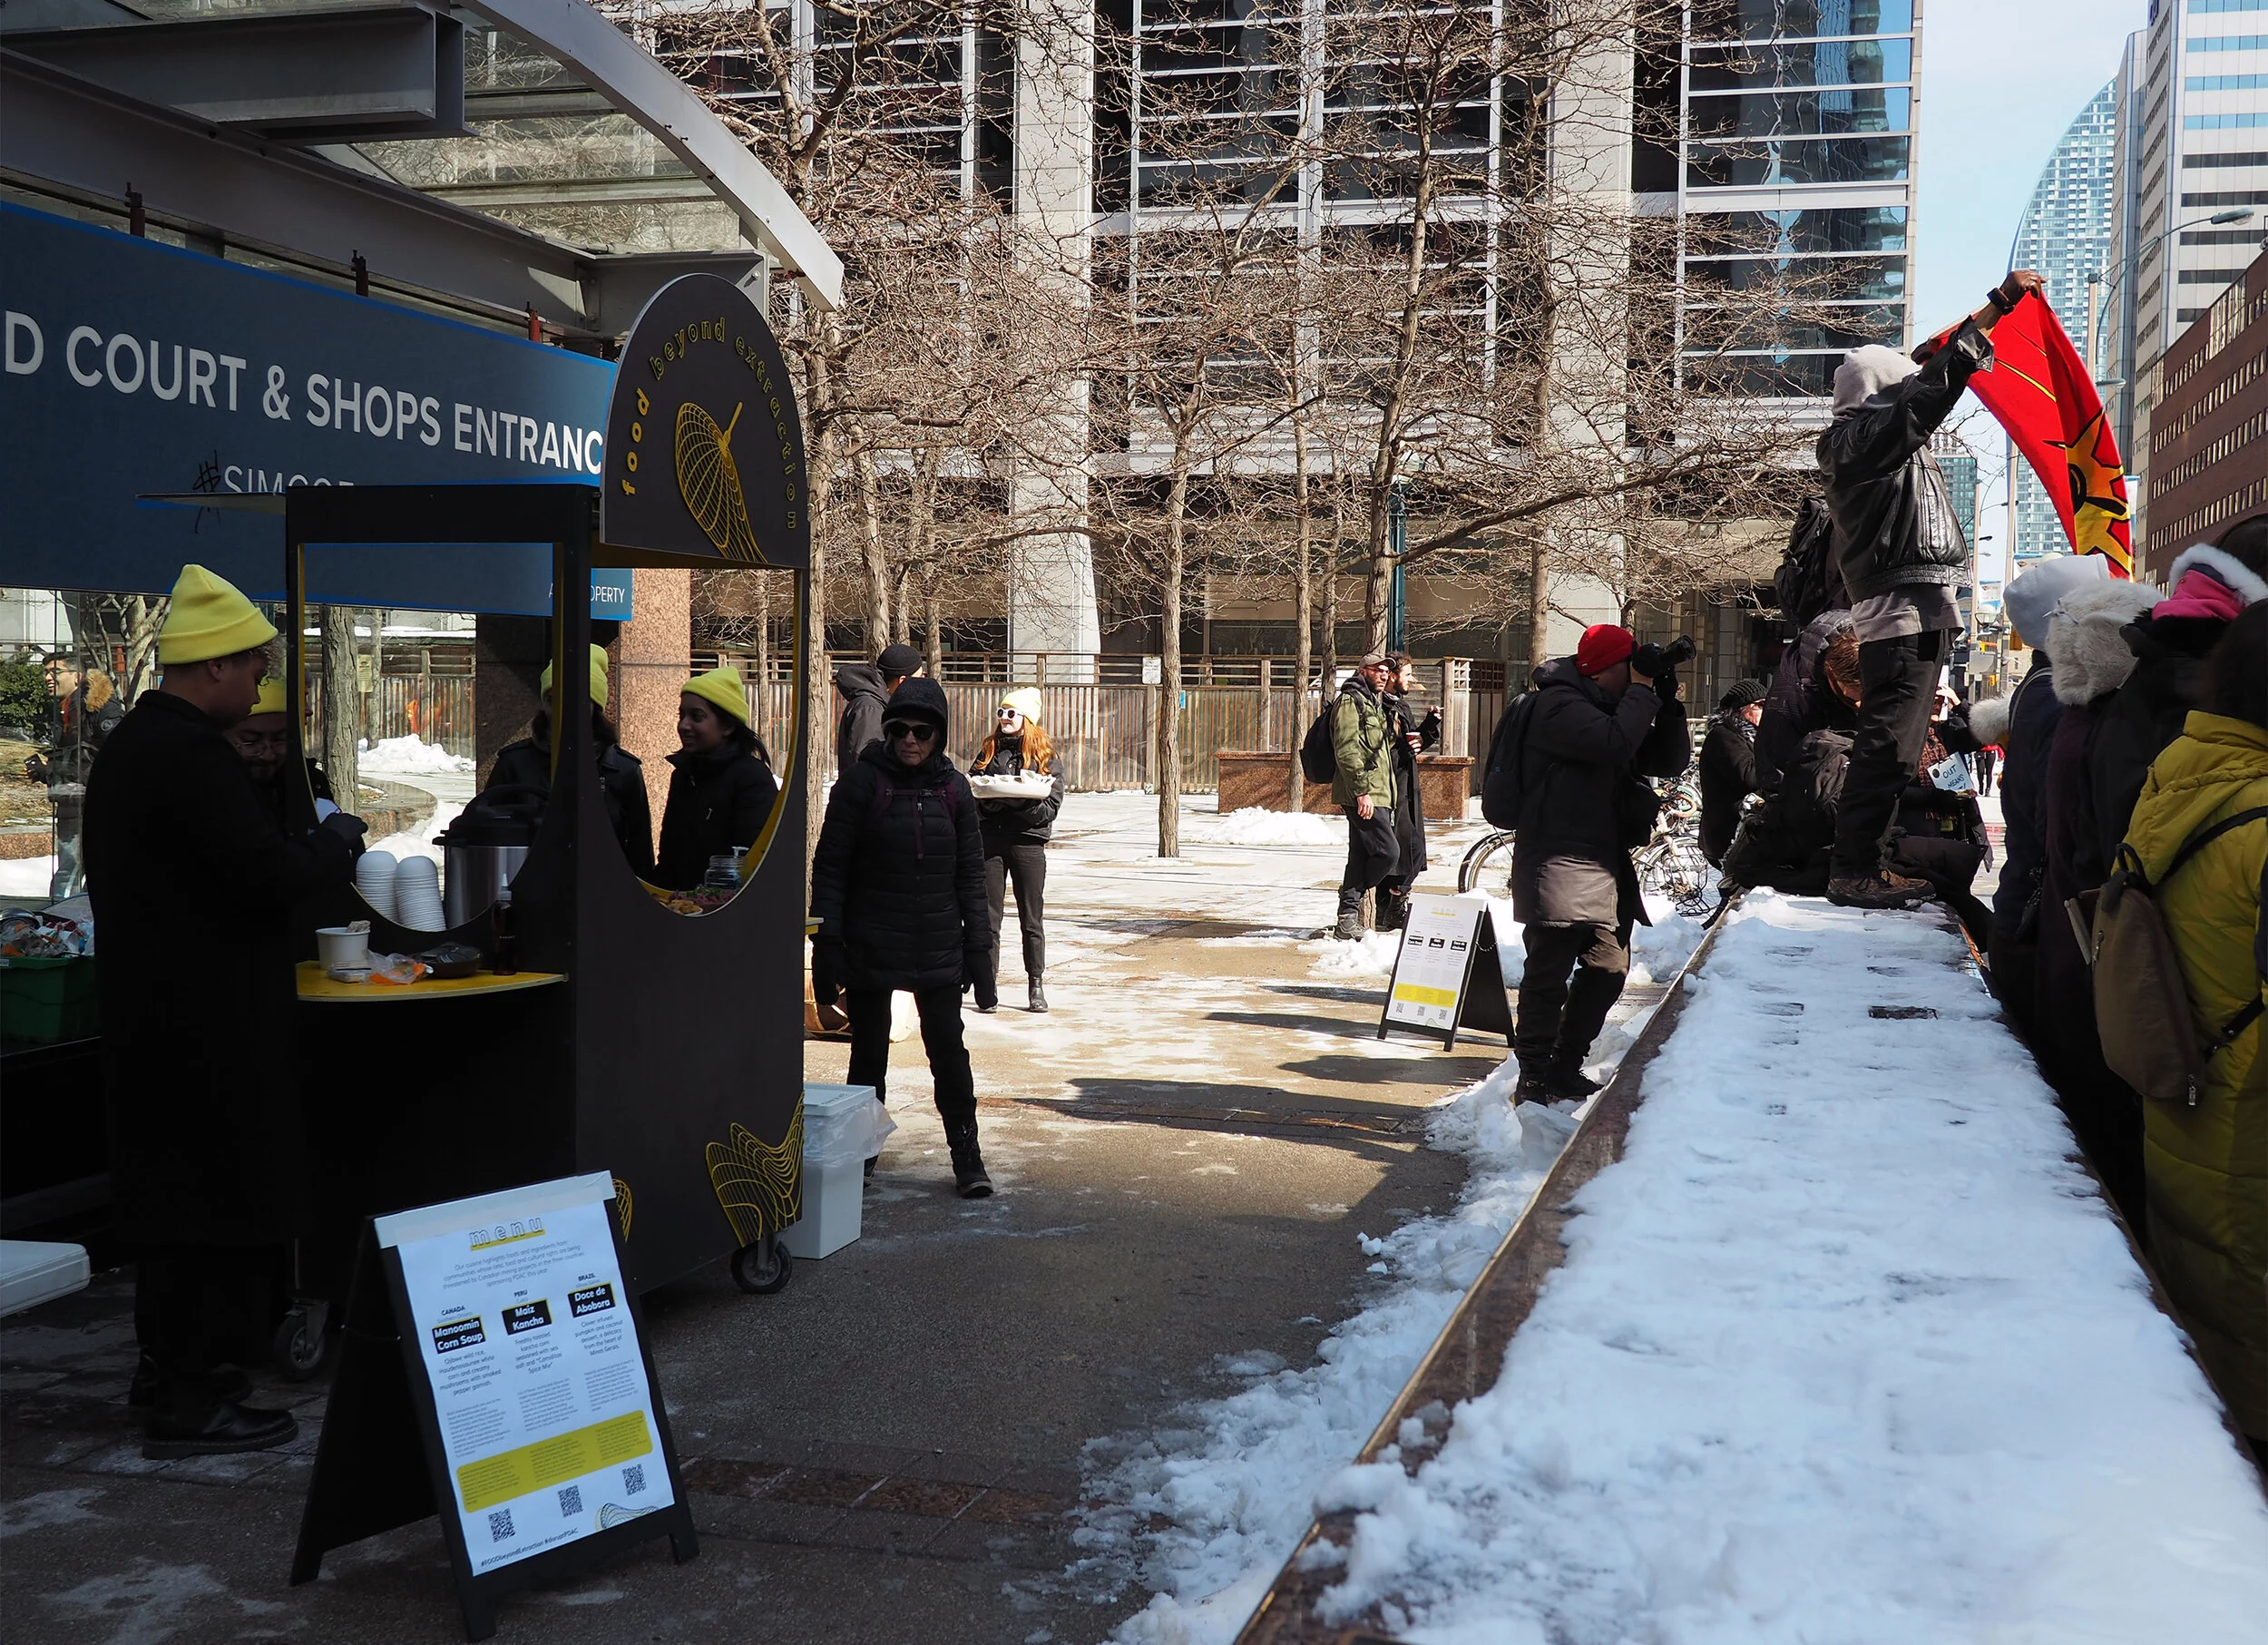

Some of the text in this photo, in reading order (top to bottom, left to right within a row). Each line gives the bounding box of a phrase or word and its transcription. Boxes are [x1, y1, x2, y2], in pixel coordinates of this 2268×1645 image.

[66, 325, 247, 411] COURT
[262, 365, 291, 421] &
[306, 373, 442, 446] SHOPS
[621, 317, 797, 529] food beyond extraction
[1942, 764, 1957, 778] OUT
[469, 1218, 543, 1247] menu
[578, 1272, 595, 1281] BRAZIL
[513, 1289, 528, 1297] PERU
[573, 1287, 605, 1301] Doce de
[441, 1305, 465, 1316] CANADA
[512, 1316, 544, 1331] Kancha
[436, 1334, 483, 1350] Corn Soup
